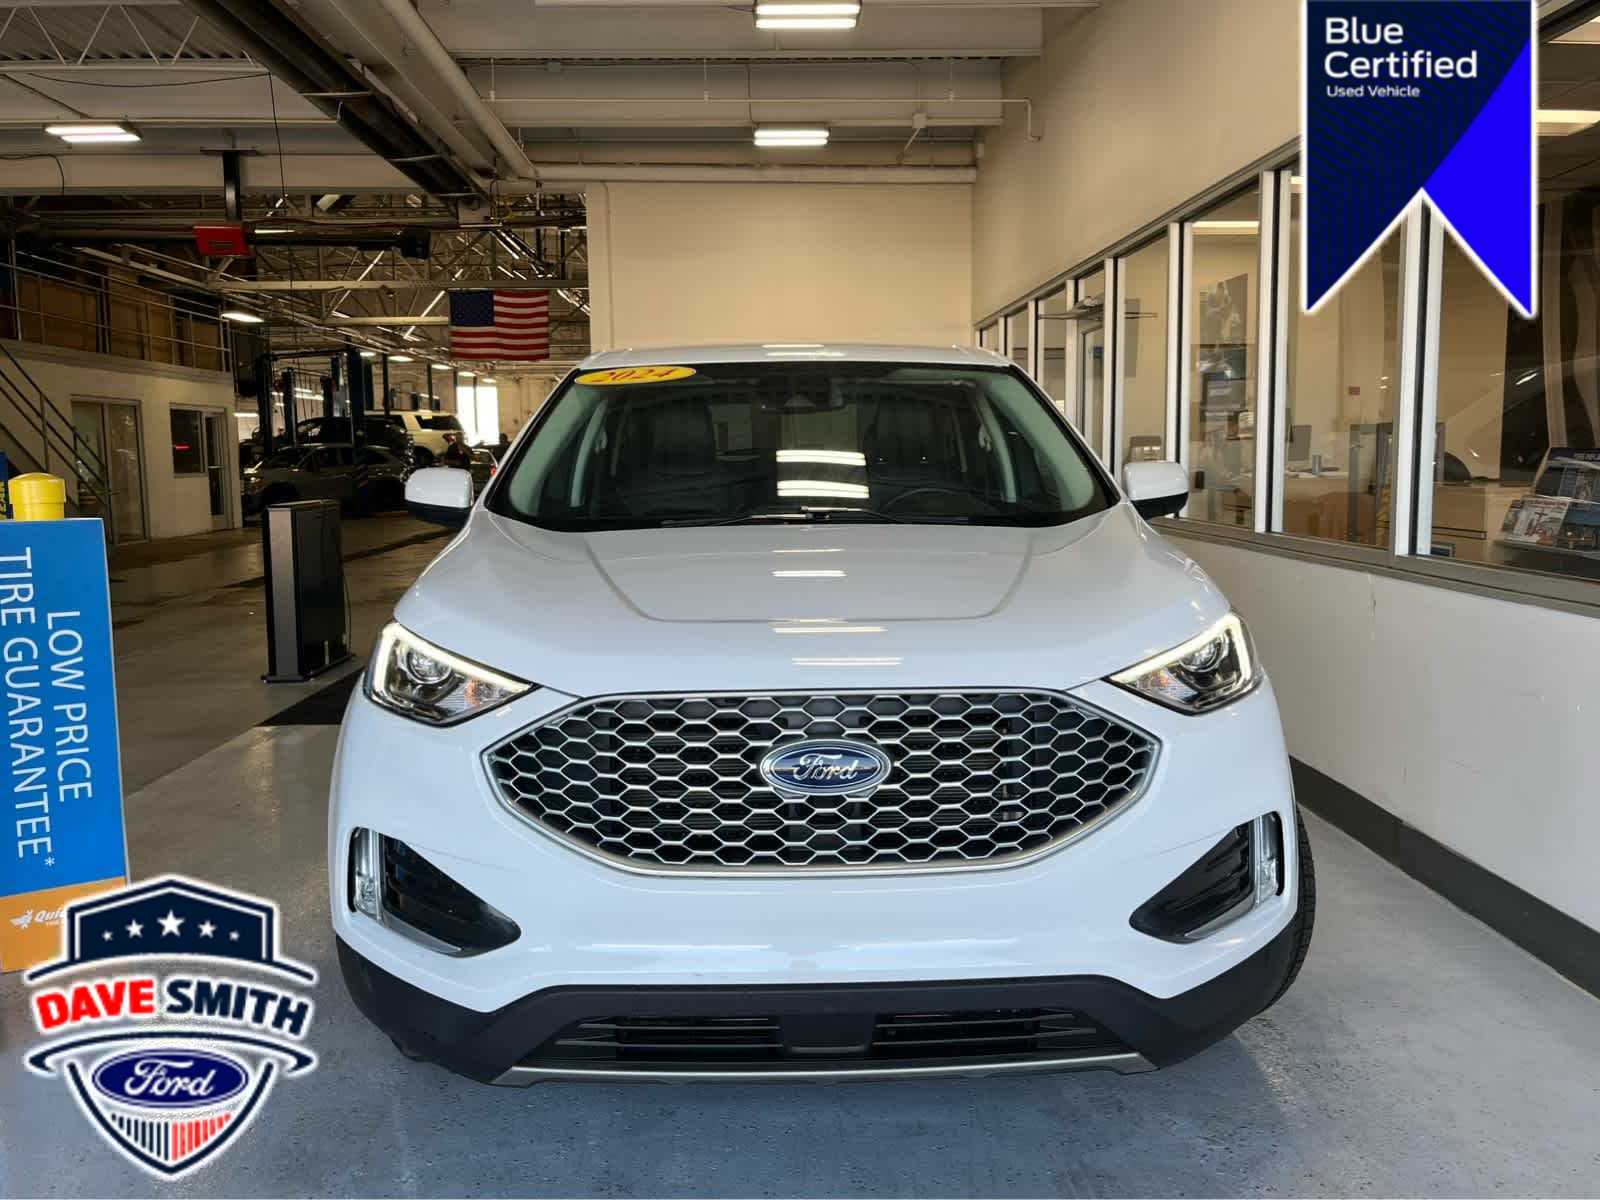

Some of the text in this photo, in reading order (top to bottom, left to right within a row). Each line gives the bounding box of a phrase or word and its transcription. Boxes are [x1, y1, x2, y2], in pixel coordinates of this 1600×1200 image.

[0, 546, 36, 627] TIRE
[47, 610, 93, 803] LOW PRICE
[791, 752, 860, 781] Ford
